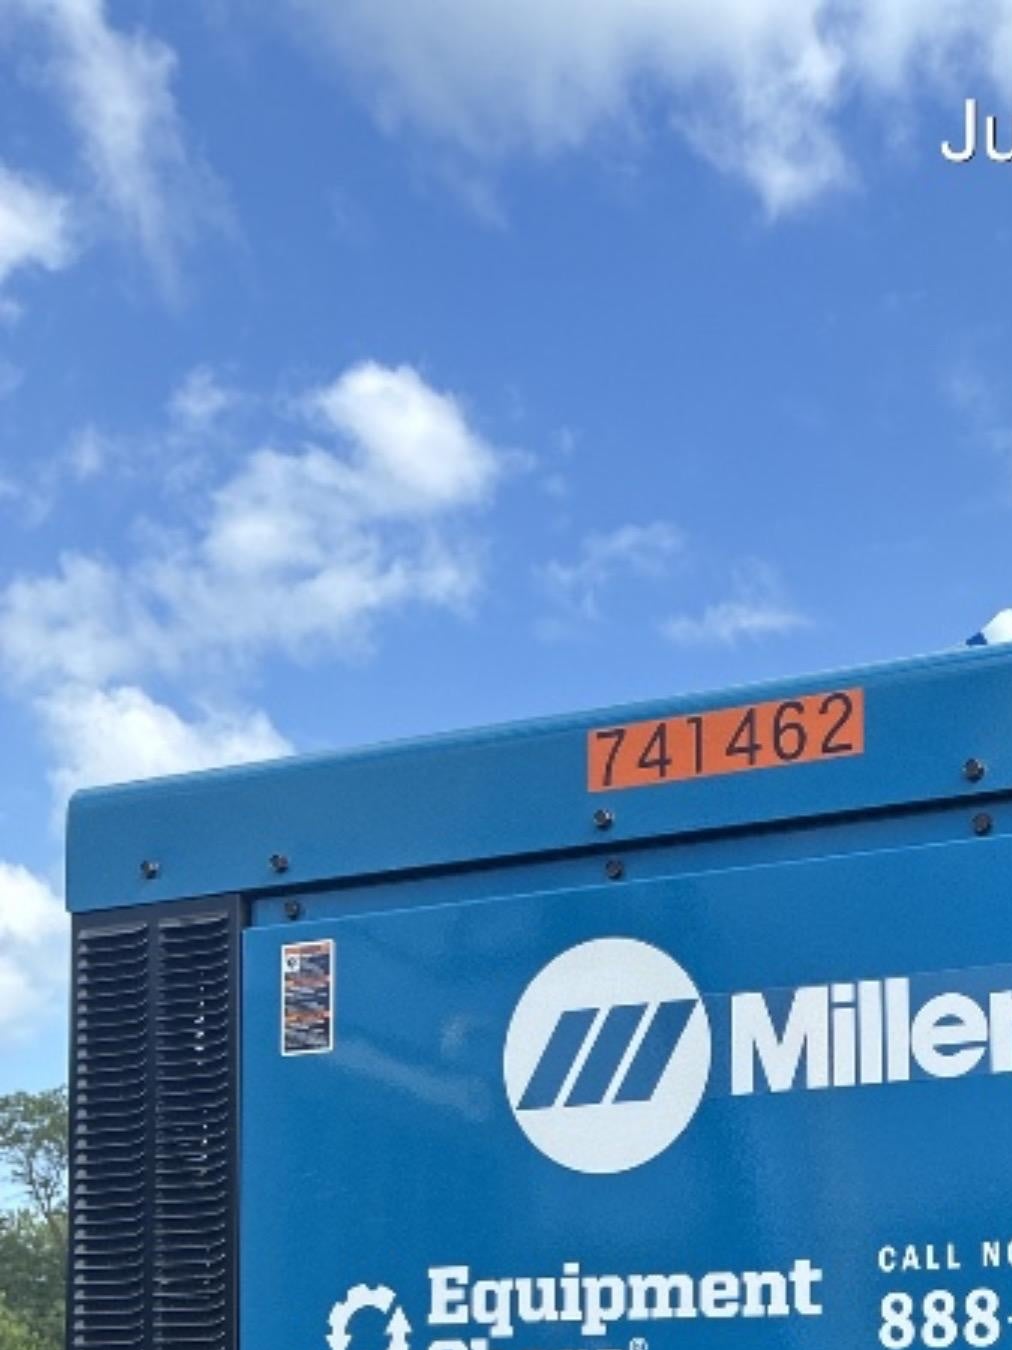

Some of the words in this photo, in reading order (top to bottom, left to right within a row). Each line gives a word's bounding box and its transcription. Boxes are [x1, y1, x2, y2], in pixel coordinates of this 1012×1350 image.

[595, 692, 854, 788] 741462
[877, 1243, 962, 1273] CALL
[426, 1259, 824, 1338] Equipment
